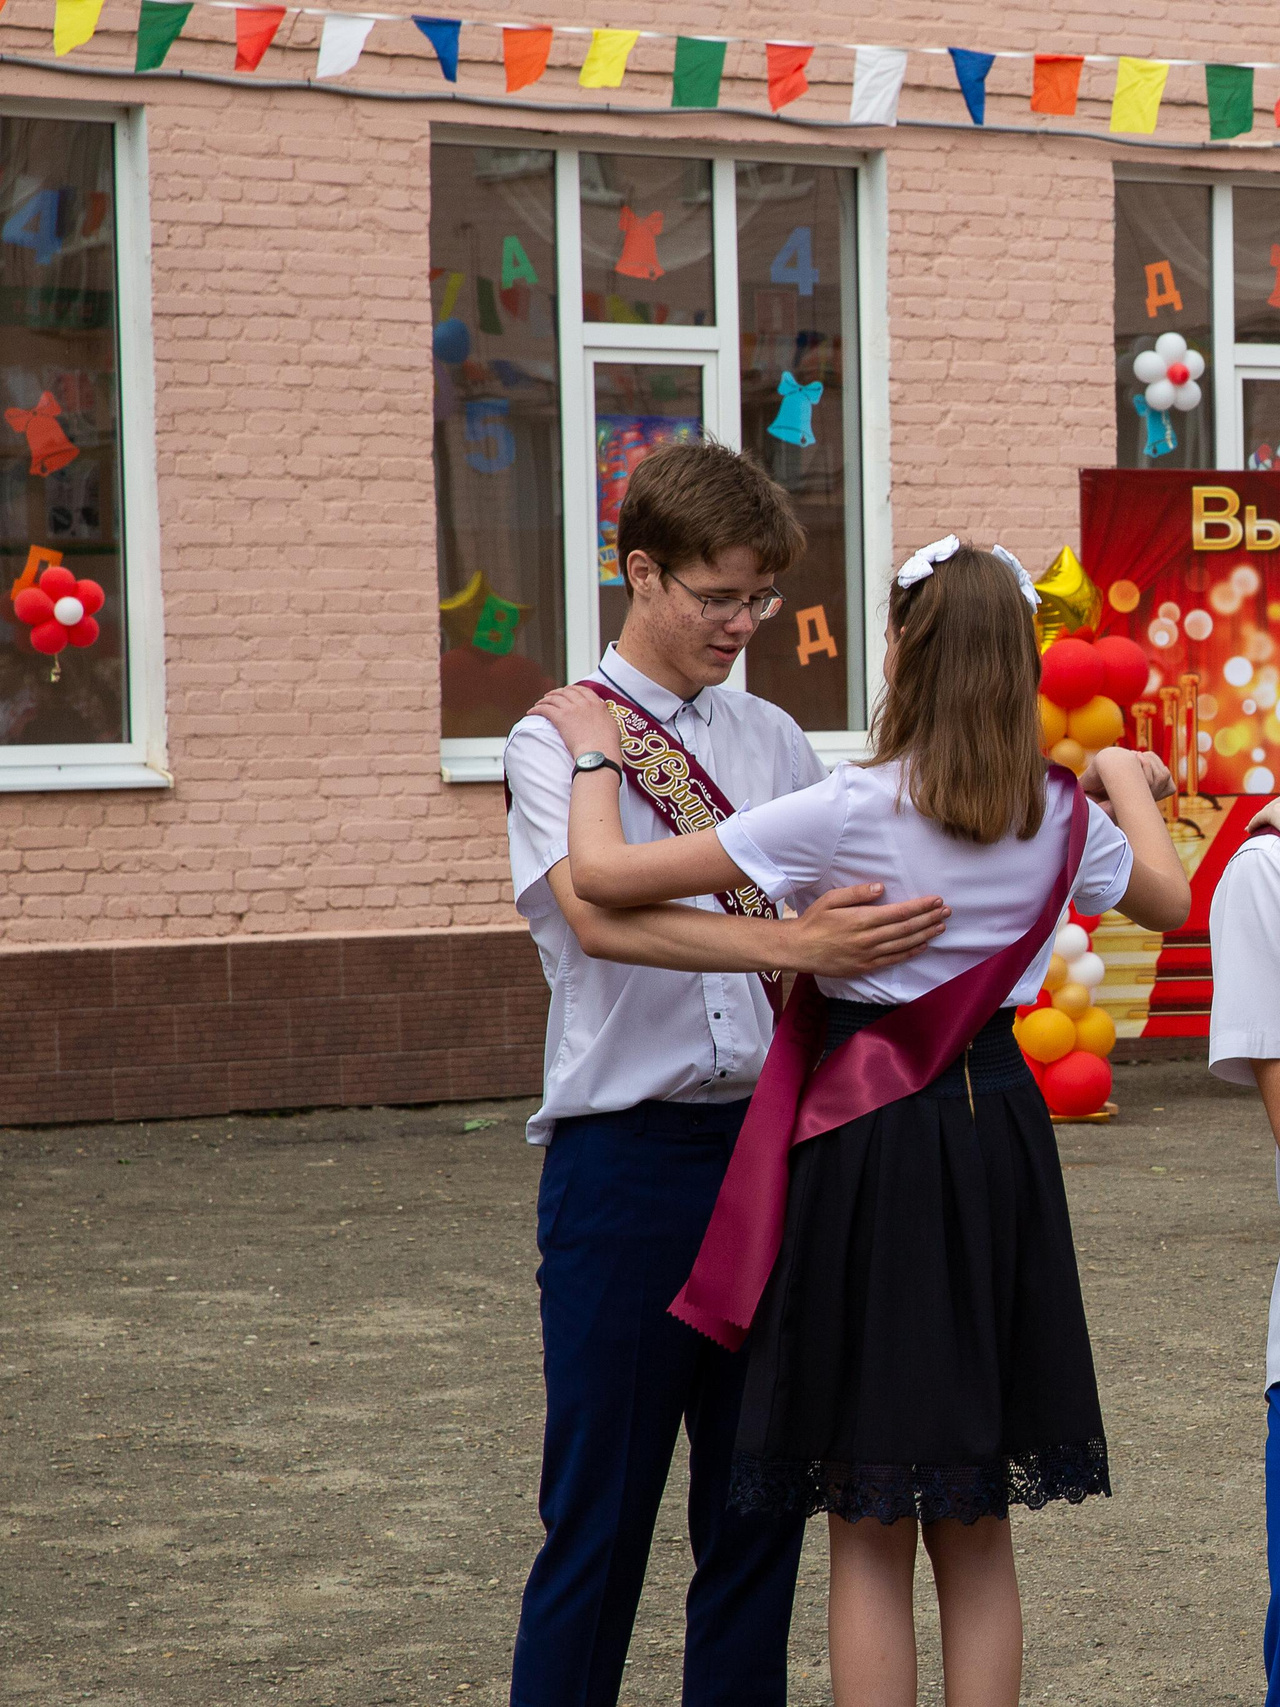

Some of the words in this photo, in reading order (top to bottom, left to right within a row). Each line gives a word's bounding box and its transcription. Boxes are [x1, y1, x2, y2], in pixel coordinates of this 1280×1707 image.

[1, 189, 63, 265] 4
[501, 236, 538, 290] А
[770, 227, 820, 296] 4
[1144, 260, 1183, 318] Д
[465, 398, 516, 474] 5
[472, 595, 520, 655] В
[796, 605, 837, 665] Д
